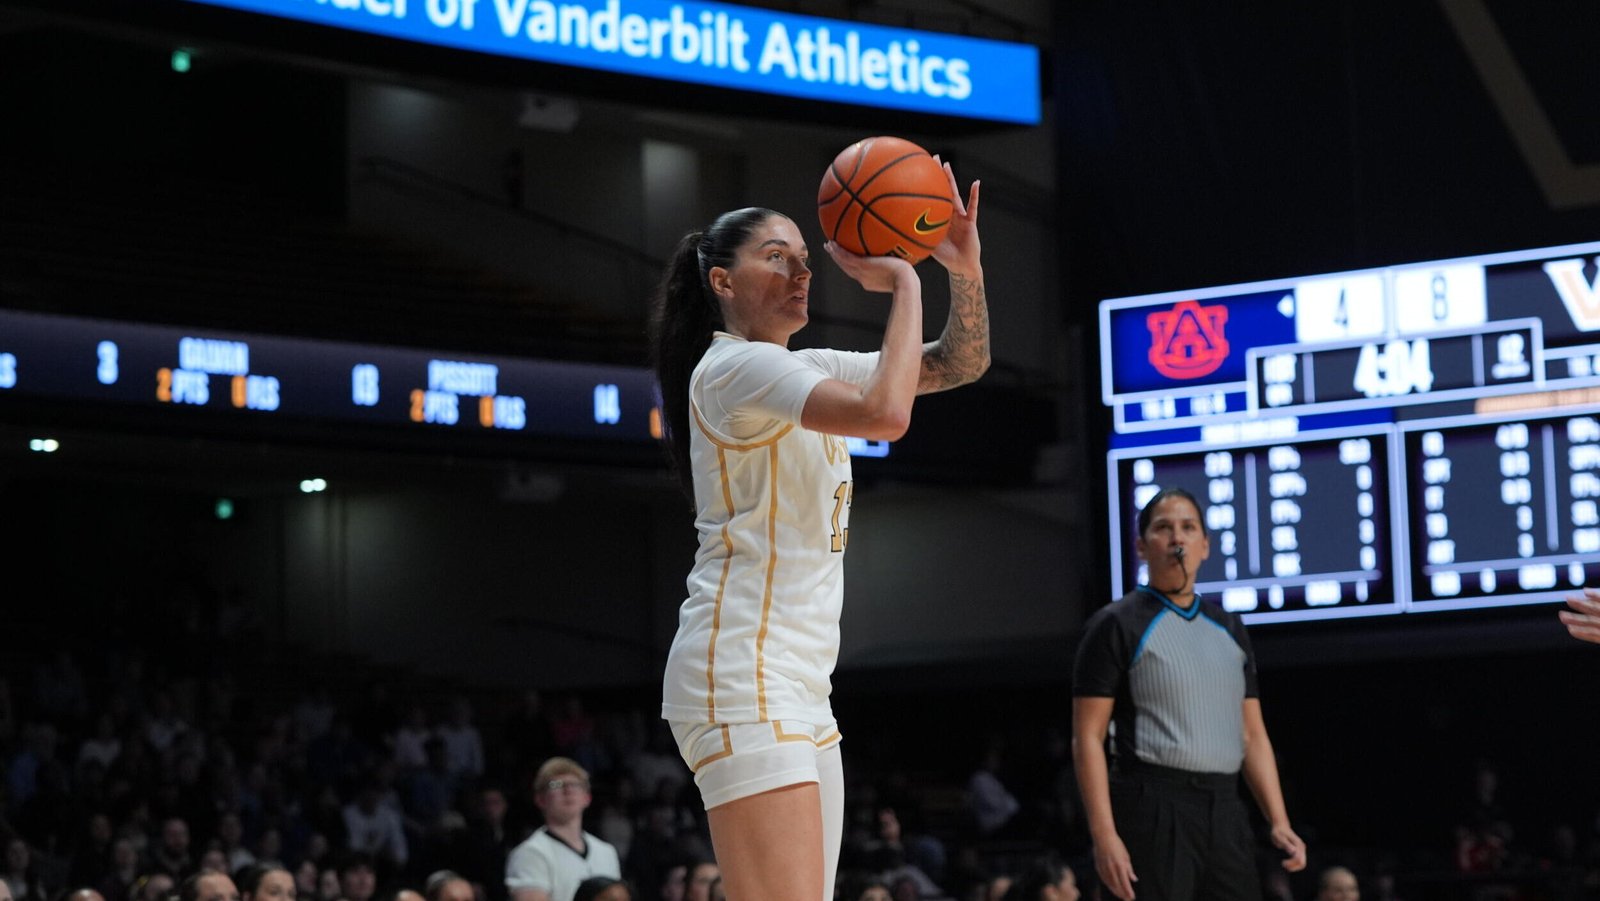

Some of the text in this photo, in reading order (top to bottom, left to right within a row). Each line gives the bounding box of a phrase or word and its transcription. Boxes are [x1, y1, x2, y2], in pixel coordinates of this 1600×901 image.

[493, 0, 750, 73] Vanderbilt
[758, 22, 972, 100] Athletics
[1333, 287, 1349, 328] 4
[1432, 274, 1448, 322] 8
[1354, 338, 1434, 398] 4:04
